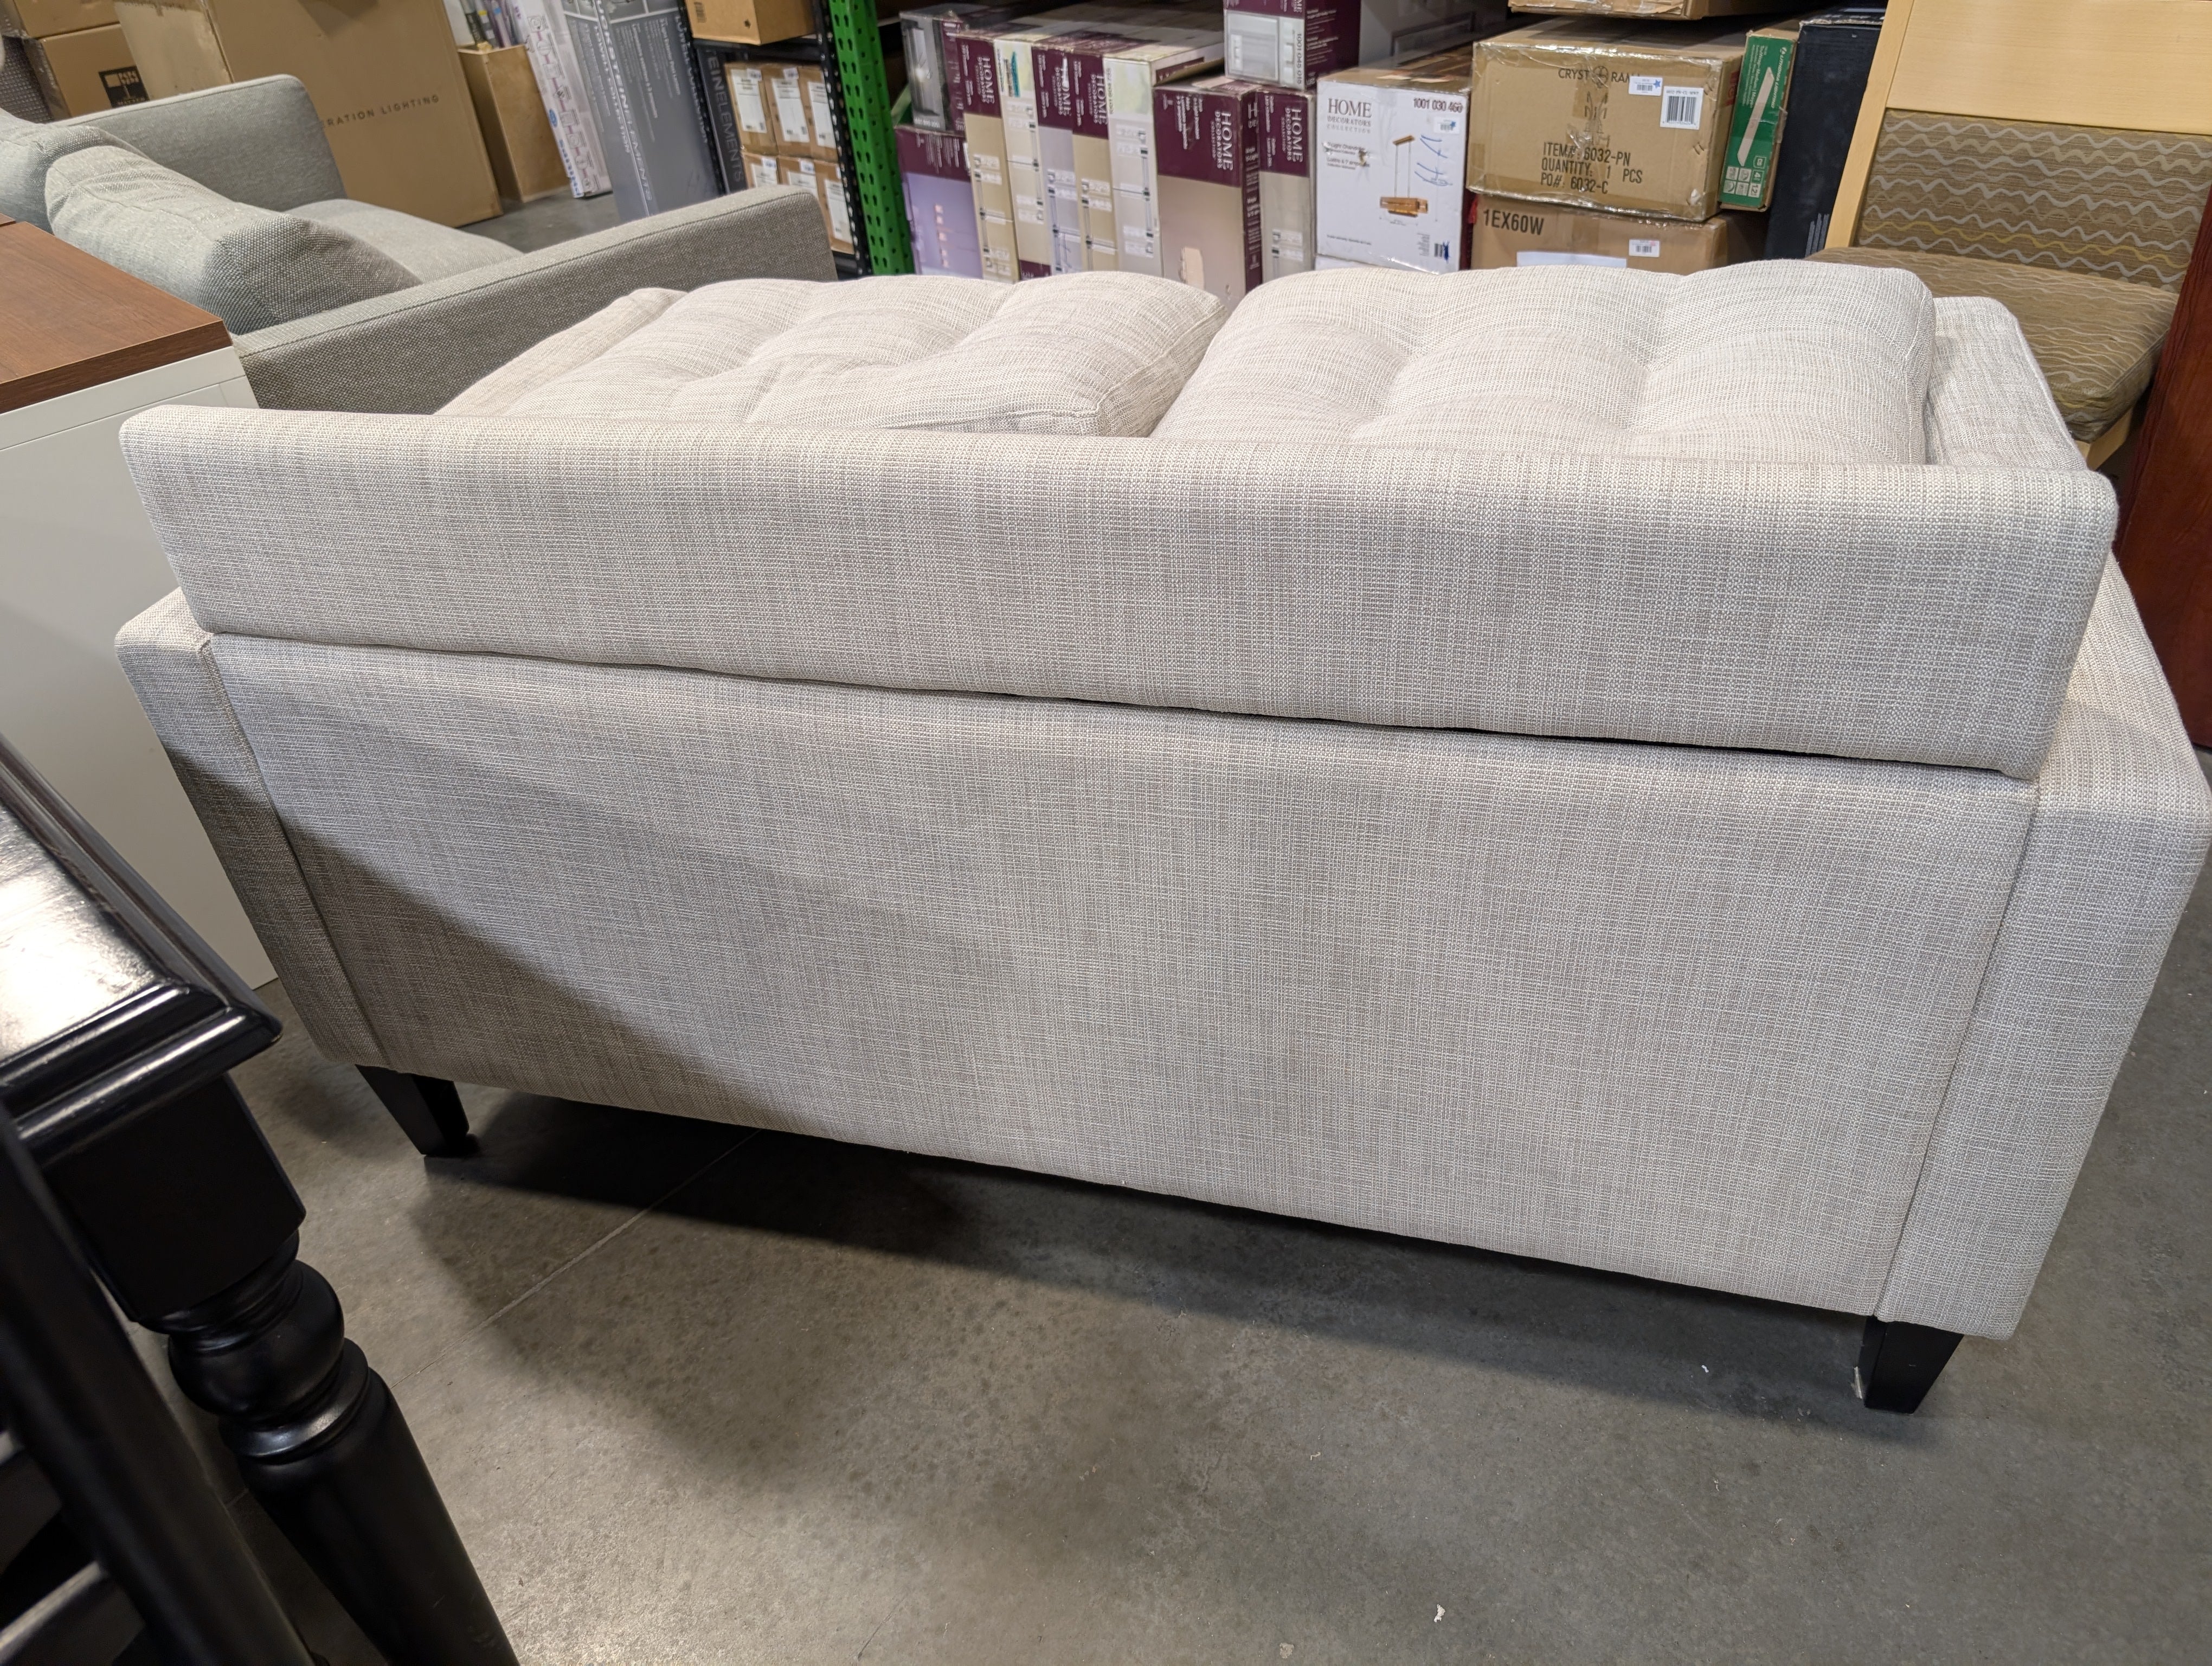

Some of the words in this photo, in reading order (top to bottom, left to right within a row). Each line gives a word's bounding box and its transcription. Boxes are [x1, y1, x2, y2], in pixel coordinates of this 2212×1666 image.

[982, 56, 995, 104] HOME
[381, 94, 439, 114] LIGHTING
[1096, 74, 1108, 124] HOME
[1328, 98, 1372, 118] HOME
[1413, 98, 1430, 109] 1001
[1214, 110, 1223, 169] DECORATORS
[1221, 112, 1233, 170] HOME
[1285, 107, 1293, 161] DECORATORS
[1291, 109, 1303, 162] HOME
[1541, 157, 1593, 177] QUANTITY:
[1607, 165, 1611, 180] 1
[1622, 168, 1643, 184] PCS
[1584, 147, 1631, 167] 6032-PN
[1540, 171, 1566, 189] PO#:
[1570, 176, 1609, 195] 6032-C
[1483, 209, 1545, 235] 1EX60W
